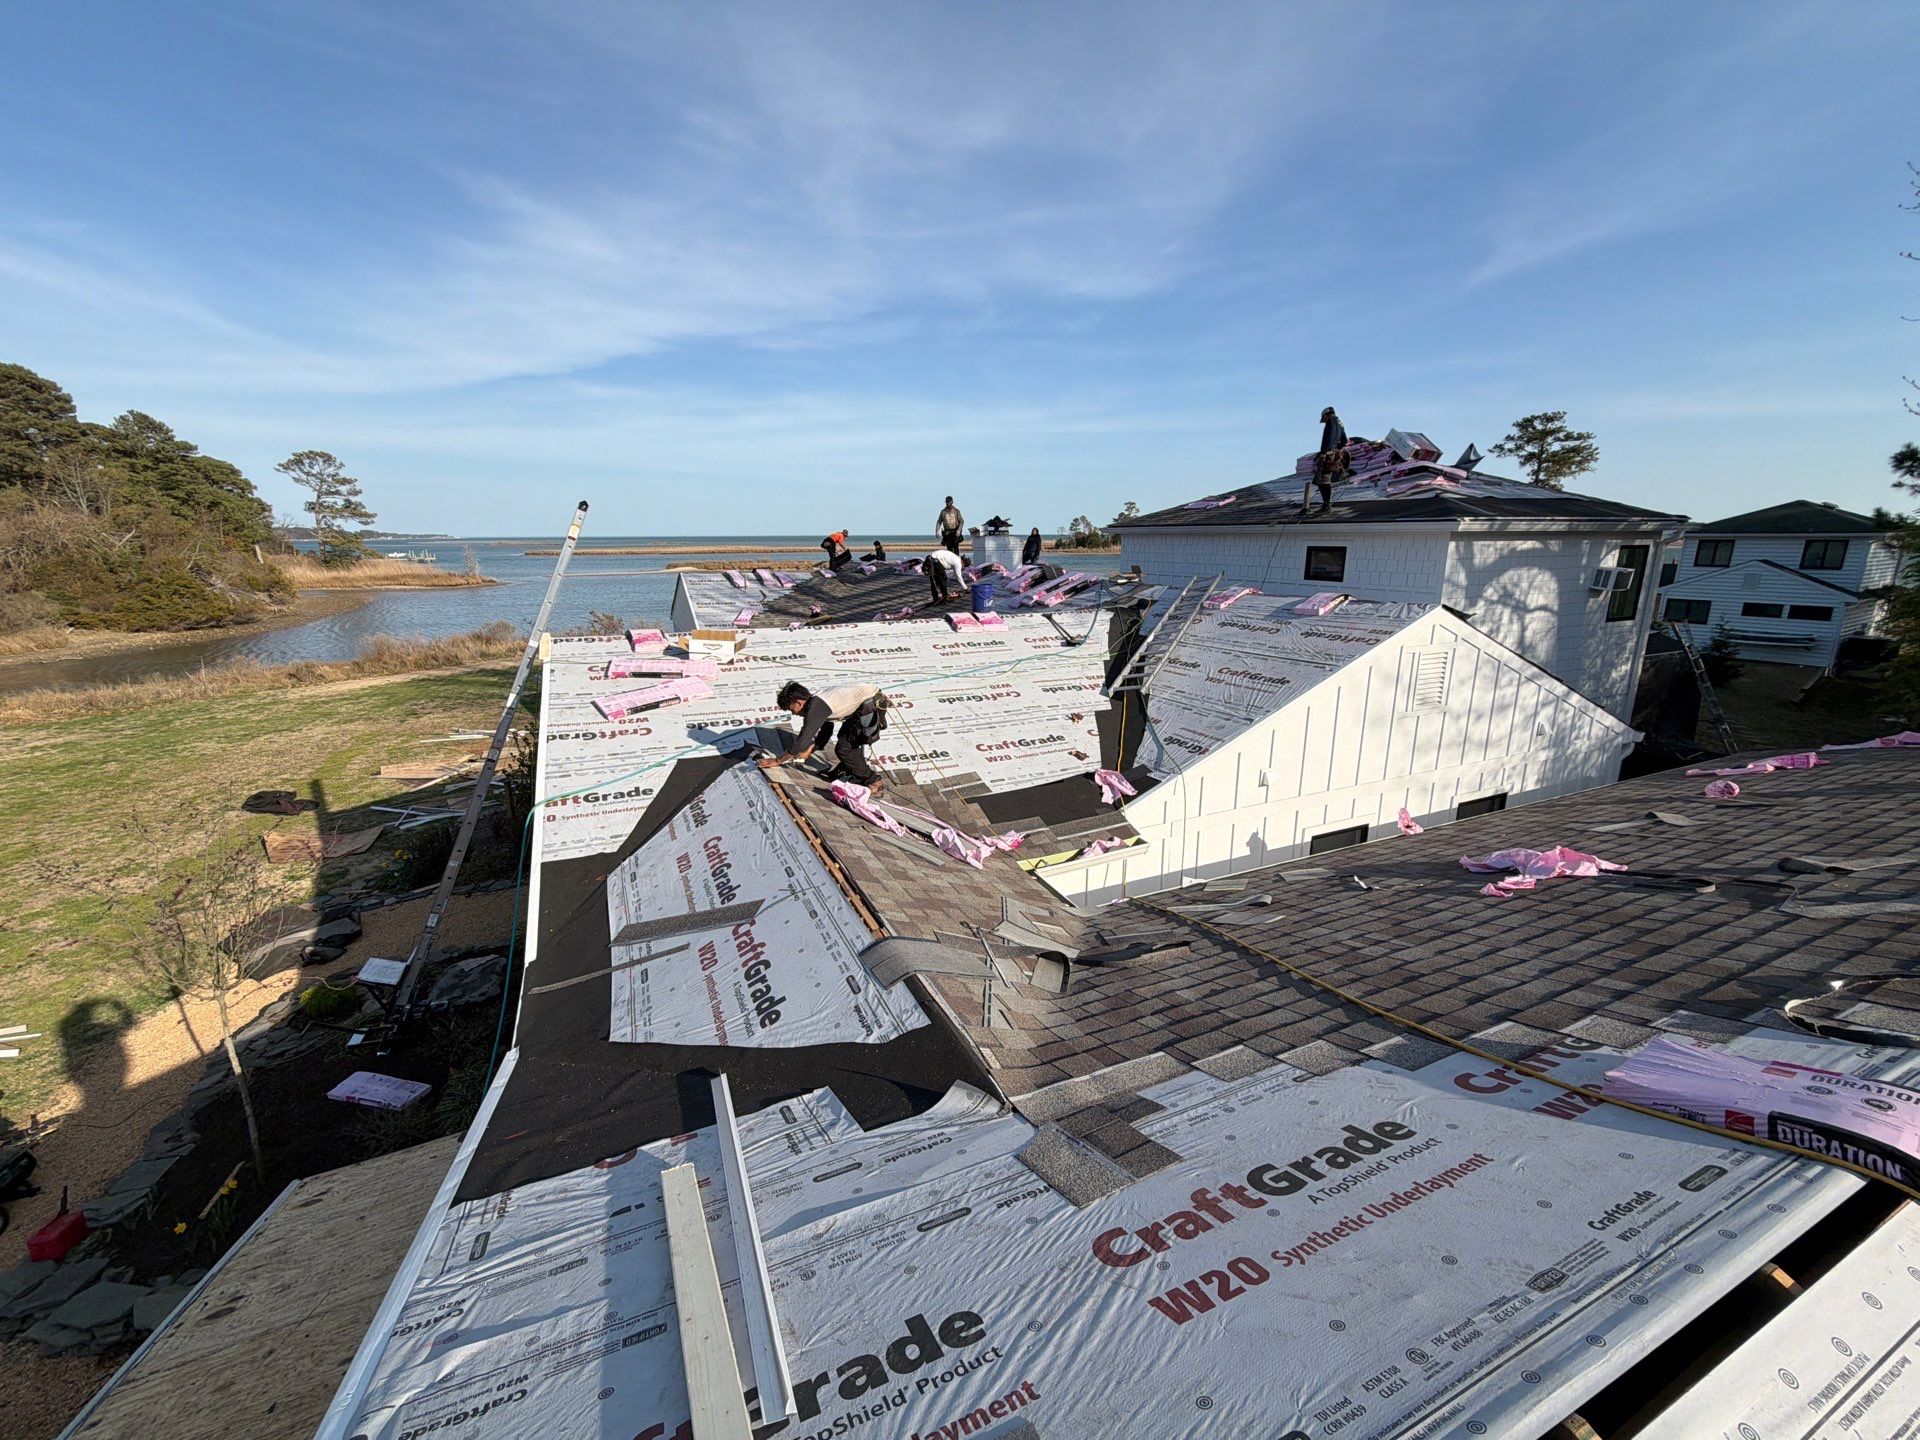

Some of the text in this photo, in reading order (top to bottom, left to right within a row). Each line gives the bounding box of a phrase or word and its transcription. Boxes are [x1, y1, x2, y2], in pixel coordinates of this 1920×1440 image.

[932, 639, 1005, 650] CraftGrade
[1300, 630, 1381, 646] CraftGrade
[831, 646, 911, 657] CraftGrade
[1217, 666, 1290, 687] CraftGrade
[938, 690, 1021, 704] CraftGrade
[546, 727, 652, 743] CraftGrad
[975, 733, 1066, 752] CraftGrade
[869, 750, 949, 766] aftGrade
[985, 754, 1012, 763] W20
[544, 787, 655, 808] aftGrade
[561, 812, 600, 822] Synthetic
[676, 852, 692, 875] W20
[703, 835, 741, 906] CraftGrade
[698, 940, 718, 971] W20
[732, 918, 786, 1029] CraftGrade
[885, 1137, 952, 1164] CraftGrade
[1777, 1124, 1904, 1181] DURATION
[1307, 1135, 1443, 1206] A TopShield Product
[1092, 1118, 1417, 1268] CraftGrade
[1589, 1191, 1655, 1230] CraftGrade
[1147, 1151, 1496, 1327] W20 Synthetic Underlayment
[1618, 1228, 1641, 1242] W20
[836, 1249, 855, 1259] CLASS
[845, 1253, 862, 1263] ASTM
[438, 1299, 466, 1311] W20
[1431, 1317, 1475, 1347] FBC Approved
[915, 1346, 1004, 1395] Product
[1362, 1366, 1401, 1392] ASTM E108
[1888, 1365, 1903, 1379] ASTM
[497, 1374, 528, 1391] W20
[1379, 1378, 1409, 1399] CLASS A
[1808, 1354, 1870, 1413] PLASTIC CAP NAILS ROOFING NAILS
[1871, 1383, 1886, 1397] ASTM
[459, 1388, 493, 1403] Synthetic
[397, 1389, 528, 1440] CraftGrade
[1314, 1396, 1352, 1422] TDI Listed
[1425, 1414, 1450, 1433] ROOFING
[1447, 1404, 1466, 1419] NAILS
[1849, 1405, 1864, 1420] ASTM
[1324, 1405, 1367, 1435] CCRR #0439
